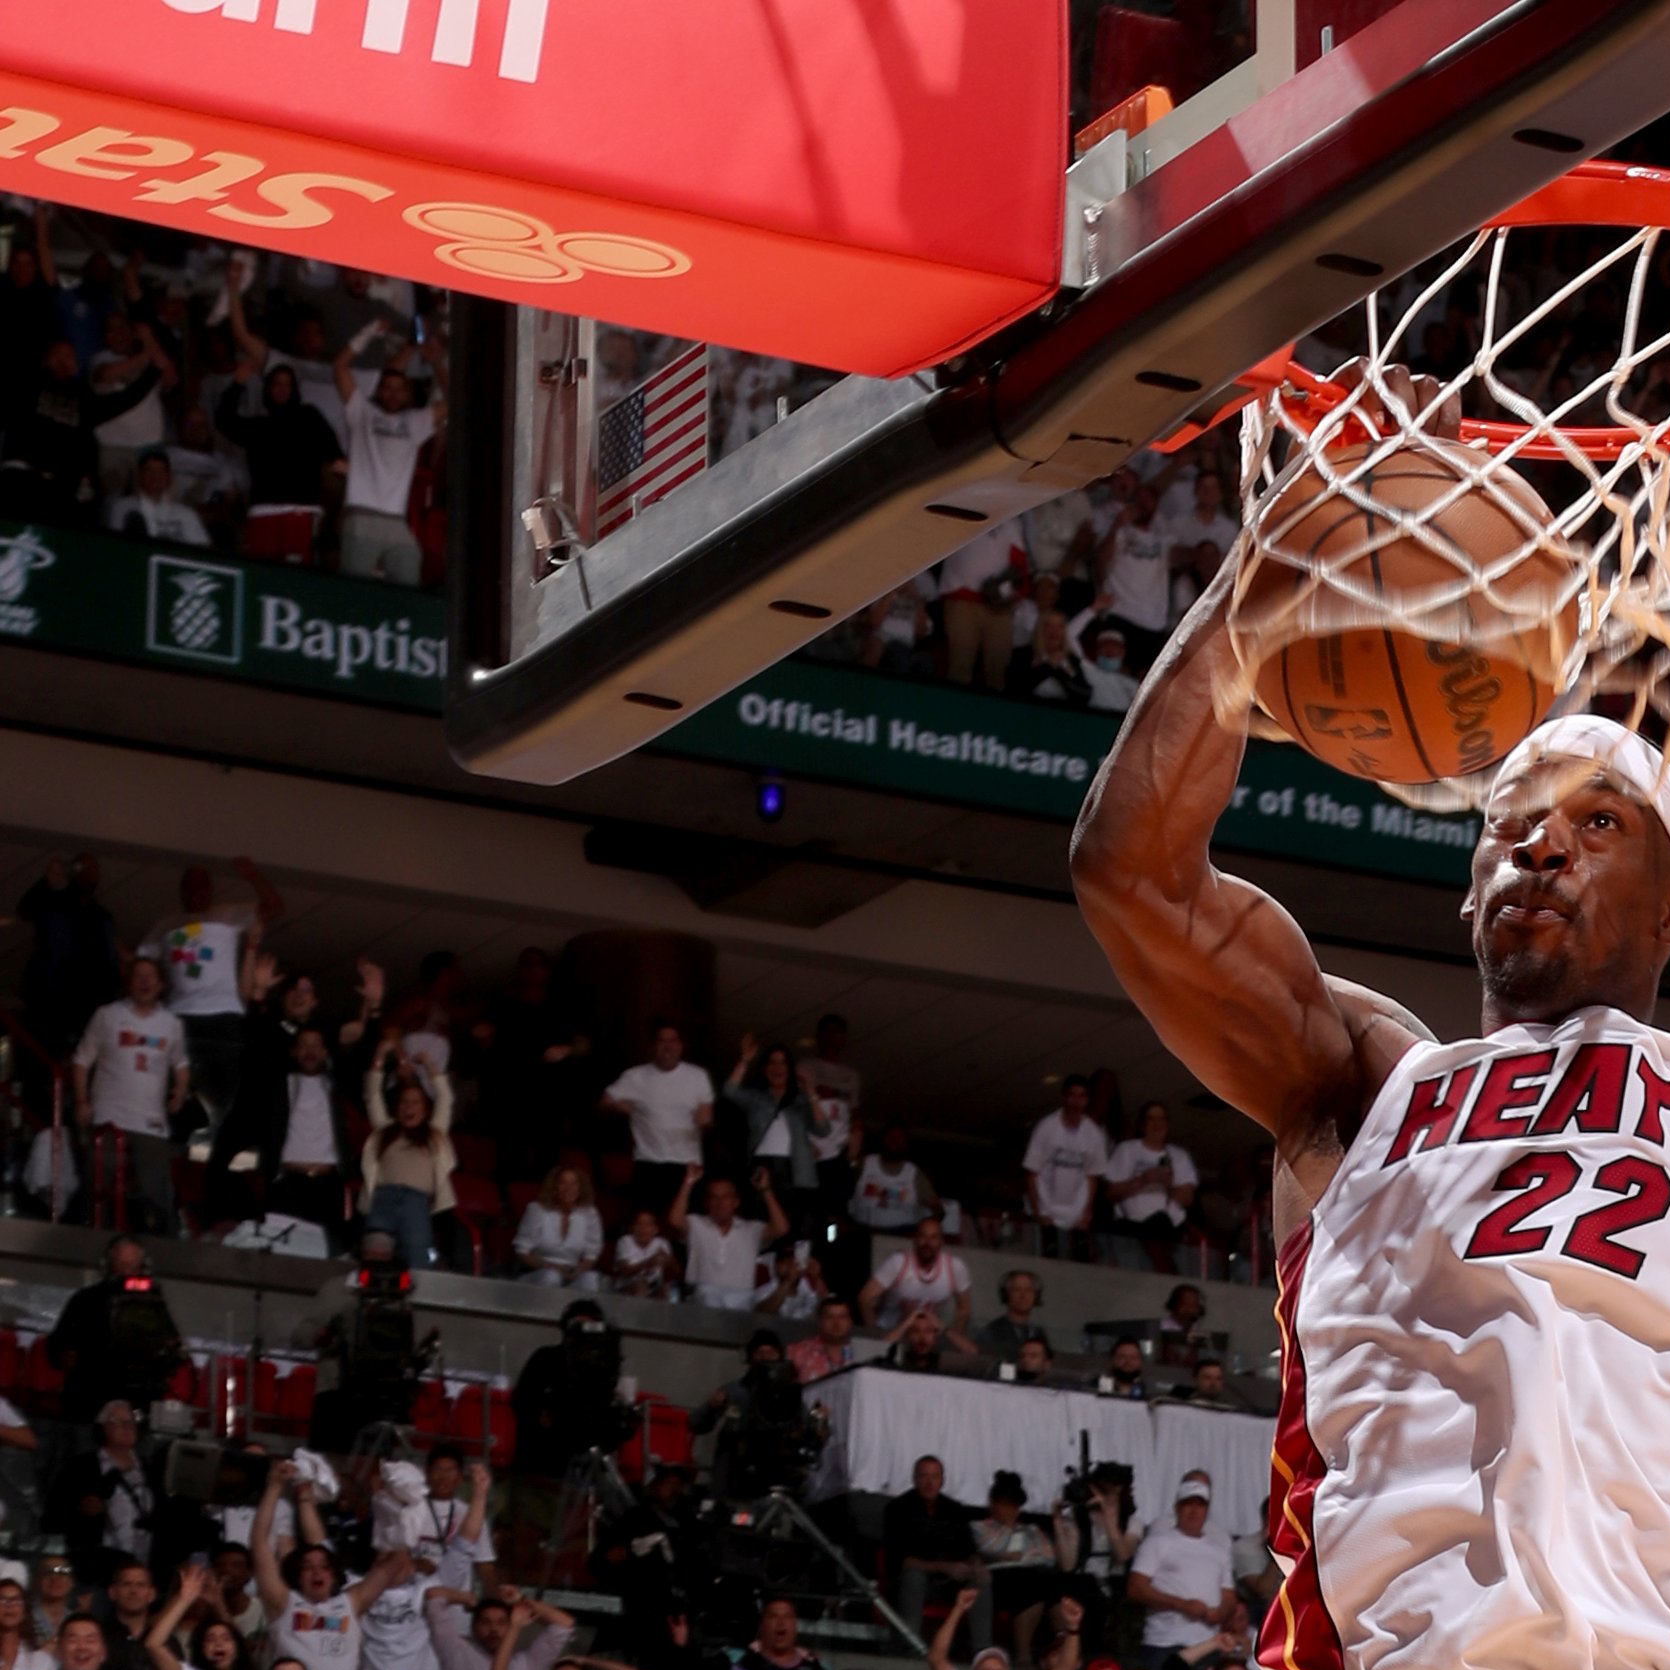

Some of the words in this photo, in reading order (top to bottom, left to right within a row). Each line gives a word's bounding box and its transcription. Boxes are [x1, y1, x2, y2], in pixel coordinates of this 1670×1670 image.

[738, 693, 877, 745] Official
[889, 719, 1088, 782] Healthcare
[1257, 787, 1296, 816] of
[1303, 793, 1362, 829] the
[1371, 803, 1477, 847] Miami
